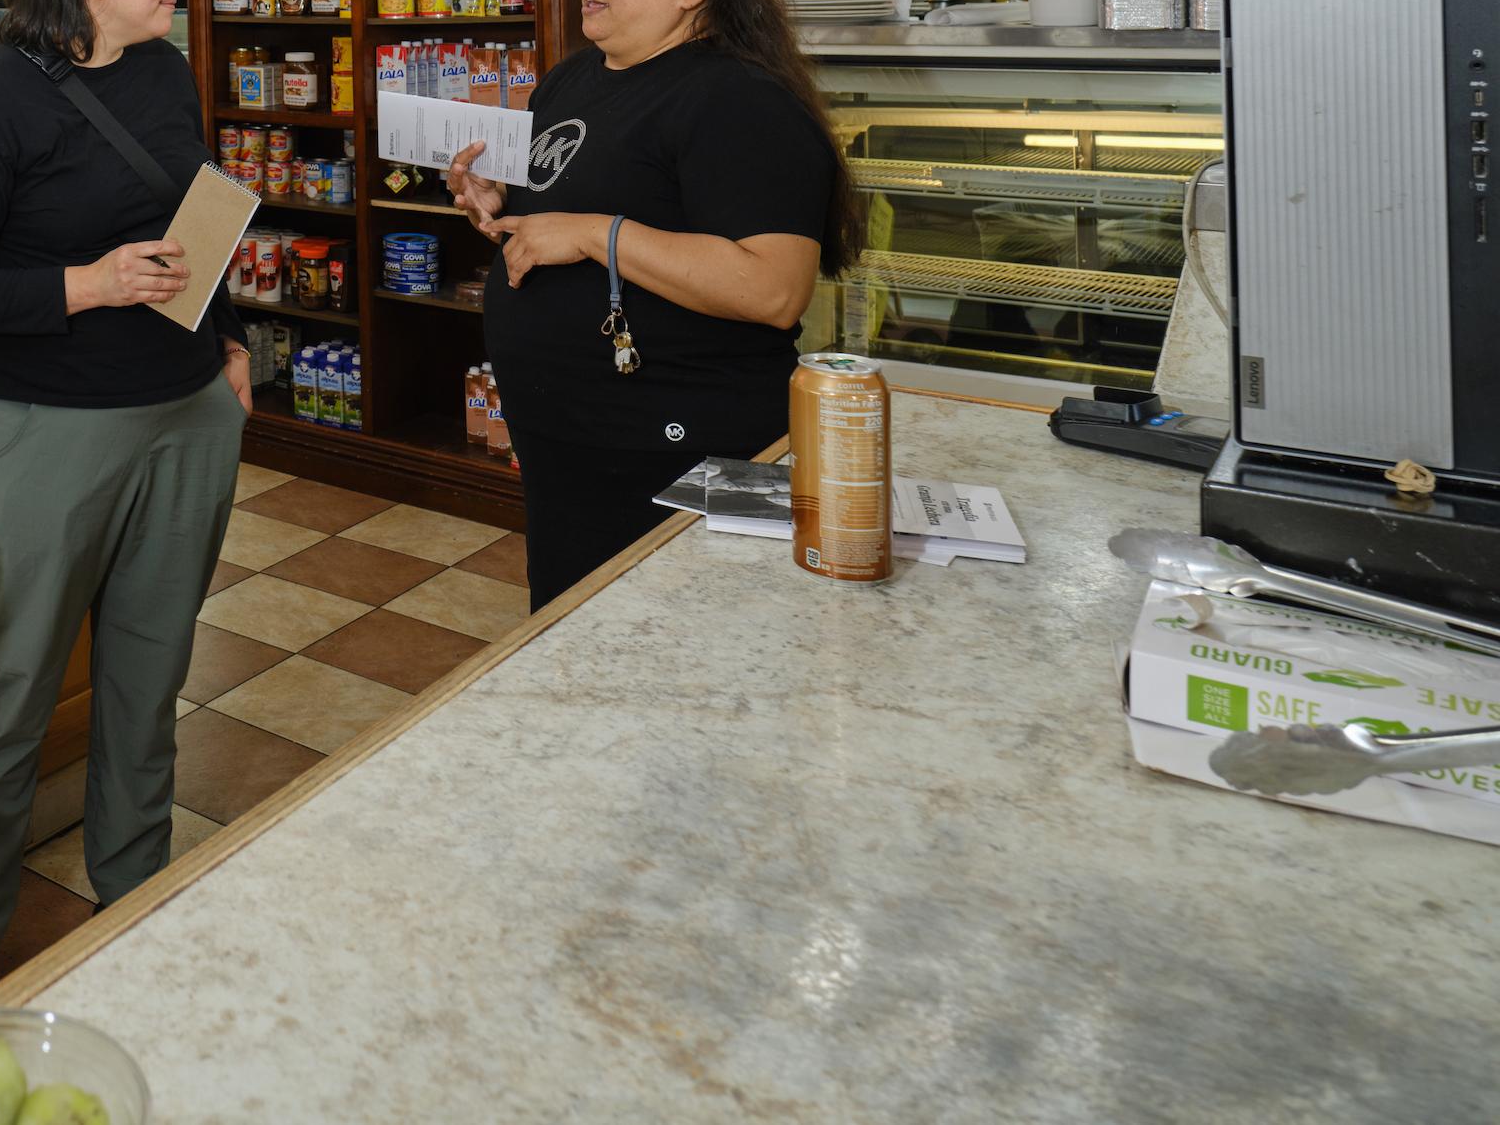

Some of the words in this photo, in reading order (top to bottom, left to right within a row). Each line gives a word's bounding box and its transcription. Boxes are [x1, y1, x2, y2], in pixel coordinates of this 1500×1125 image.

[379, 70, 405, 80] LALA
[442, 66, 467, 77] LALA
[284, 78, 308, 87] nutella
[472, 73, 498, 85] LALA
[510, 74, 535, 86] LALA
[411, 284, 432, 292] GOYA
[1247, 361, 1260, 404] Lenovo
[469, 398, 486, 408] LAL
[1190, 643, 1293, 676] GUARD
[1203, 684, 1231, 696] ONE
[1203, 693, 1231, 706] SIZE
[1203, 703, 1231, 716] FITS
[1256, 690, 1323, 727] SAFE
[1203, 713, 1230, 725] ALL
